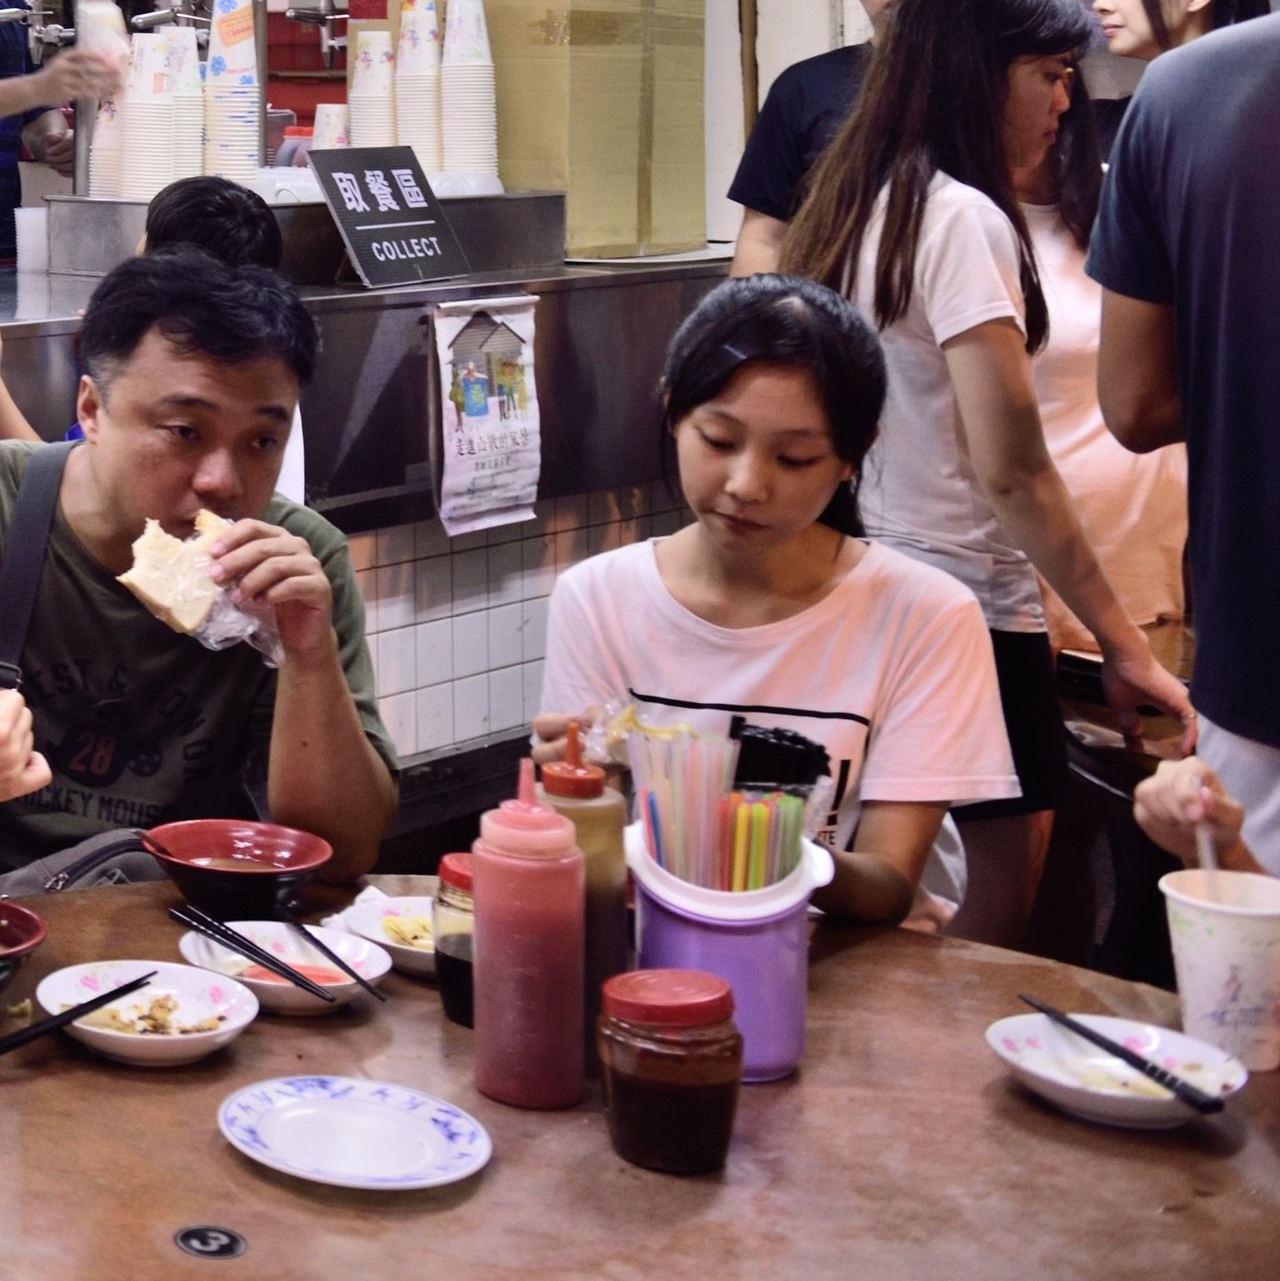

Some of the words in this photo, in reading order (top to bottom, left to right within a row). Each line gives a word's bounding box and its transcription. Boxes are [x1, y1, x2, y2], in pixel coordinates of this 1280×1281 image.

[331, 169, 429, 212] 取餐區
[371, 237, 442, 261] COLLECT
[189, 1231, 231, 1252] 3
